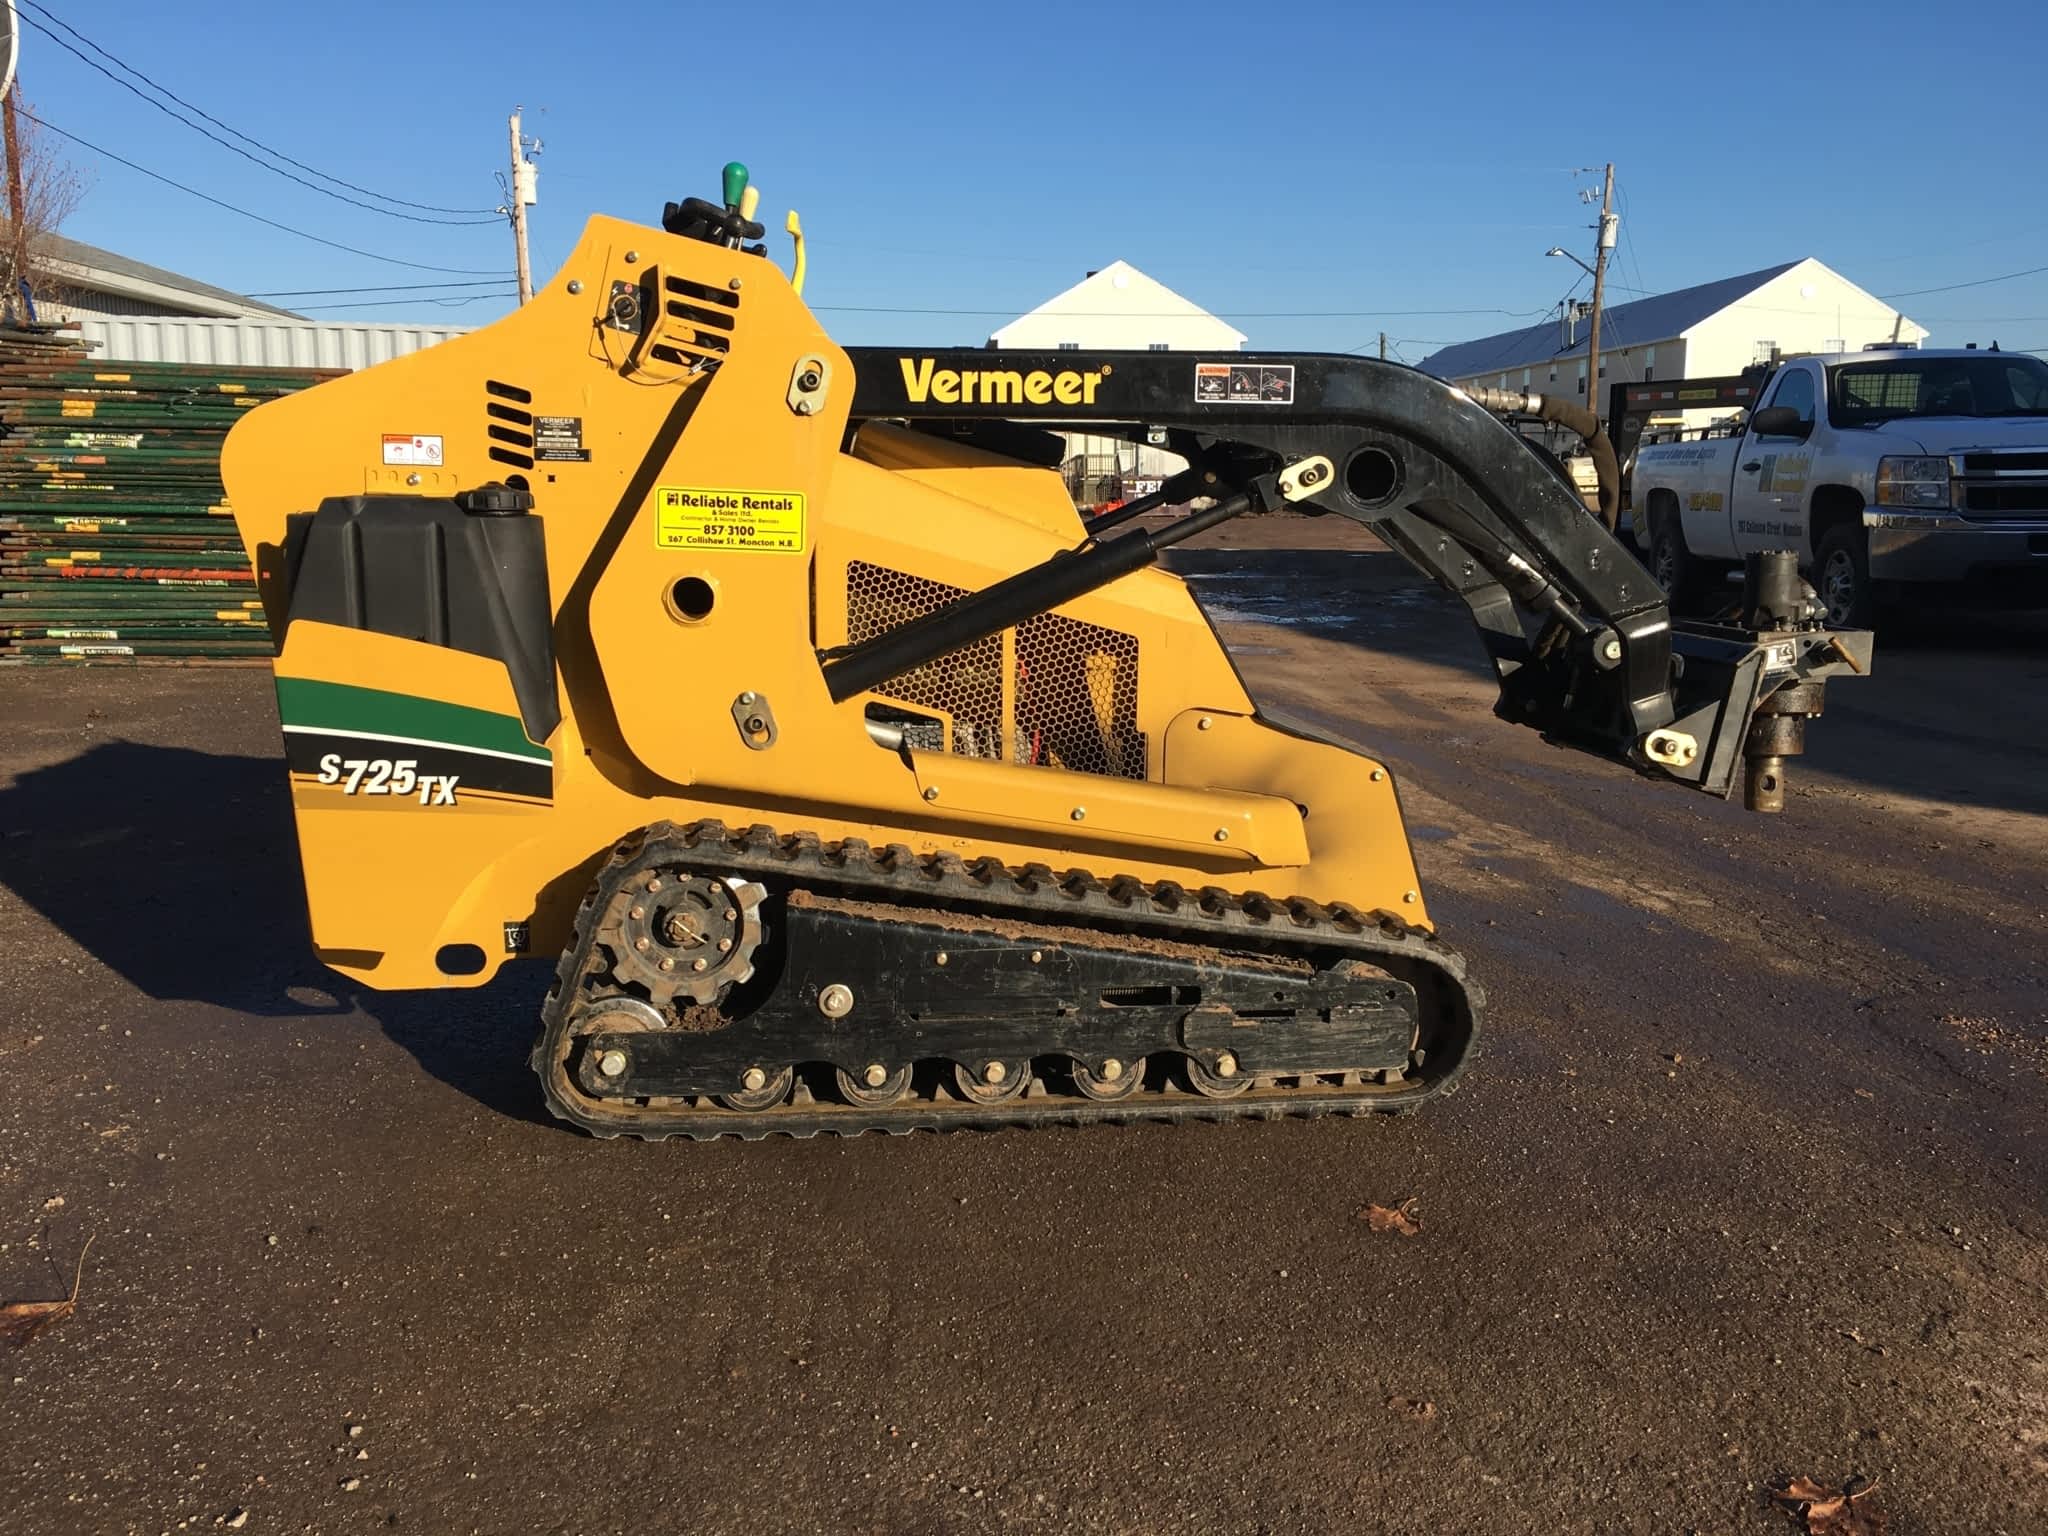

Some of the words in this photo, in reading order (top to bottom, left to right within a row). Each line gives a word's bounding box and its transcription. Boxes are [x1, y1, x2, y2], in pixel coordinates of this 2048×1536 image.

[900, 358, 1101, 405] Vermeer
[681, 494, 738, 509] Reliable
[742, 496, 793, 511] Rentals
[738, 538, 775, 546] Moncton
